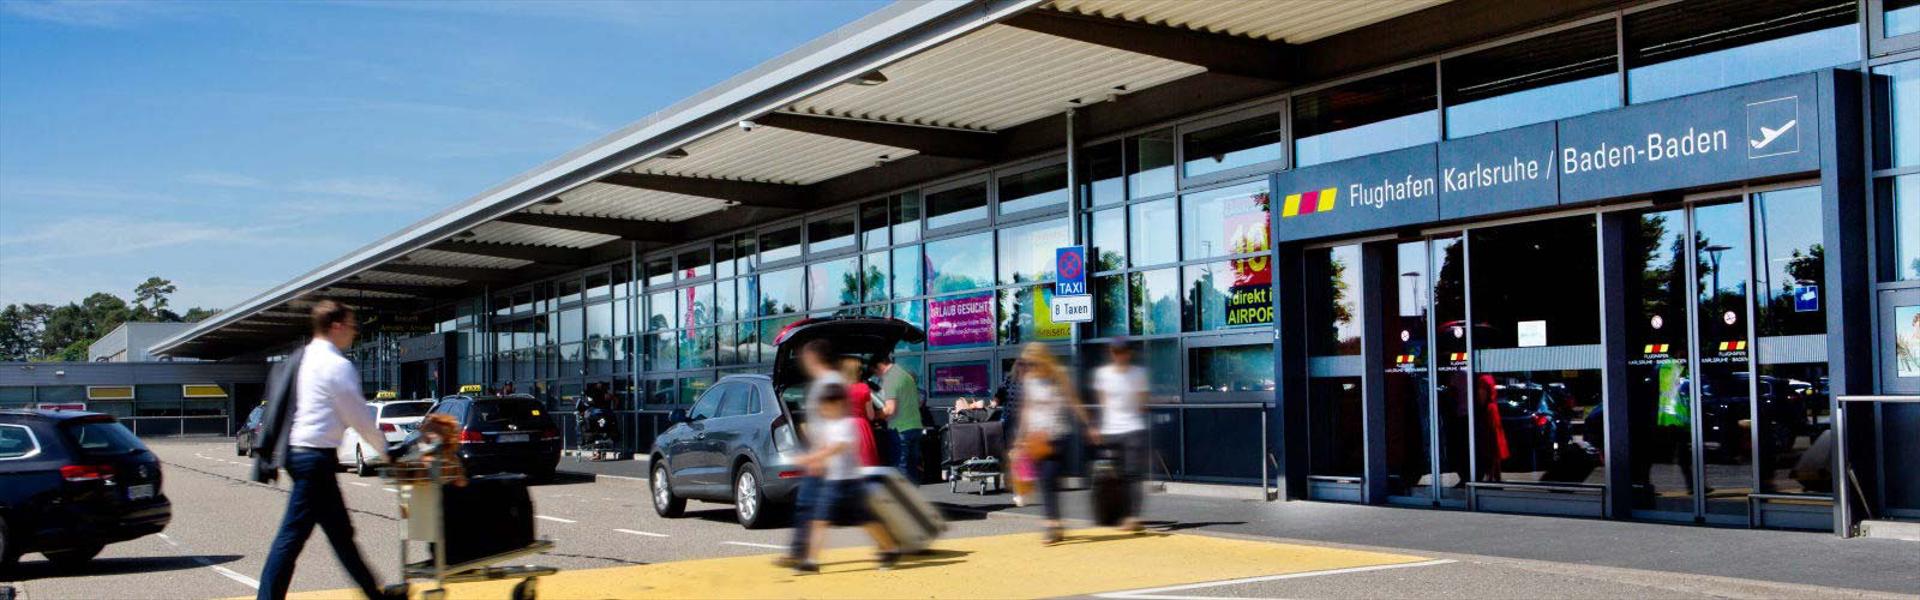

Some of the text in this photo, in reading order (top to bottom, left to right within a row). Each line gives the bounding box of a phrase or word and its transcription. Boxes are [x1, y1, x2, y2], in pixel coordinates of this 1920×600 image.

[1350, 128, 1727, 208] Flughafen Karlsruhe / Baden-Baden
[1060, 282, 1083, 294] TAXI
[1233, 288, 1266, 306] direkt
[1055, 303, 1088, 316] 8 Taxen
[1228, 307, 1274, 325] AIRPOR
